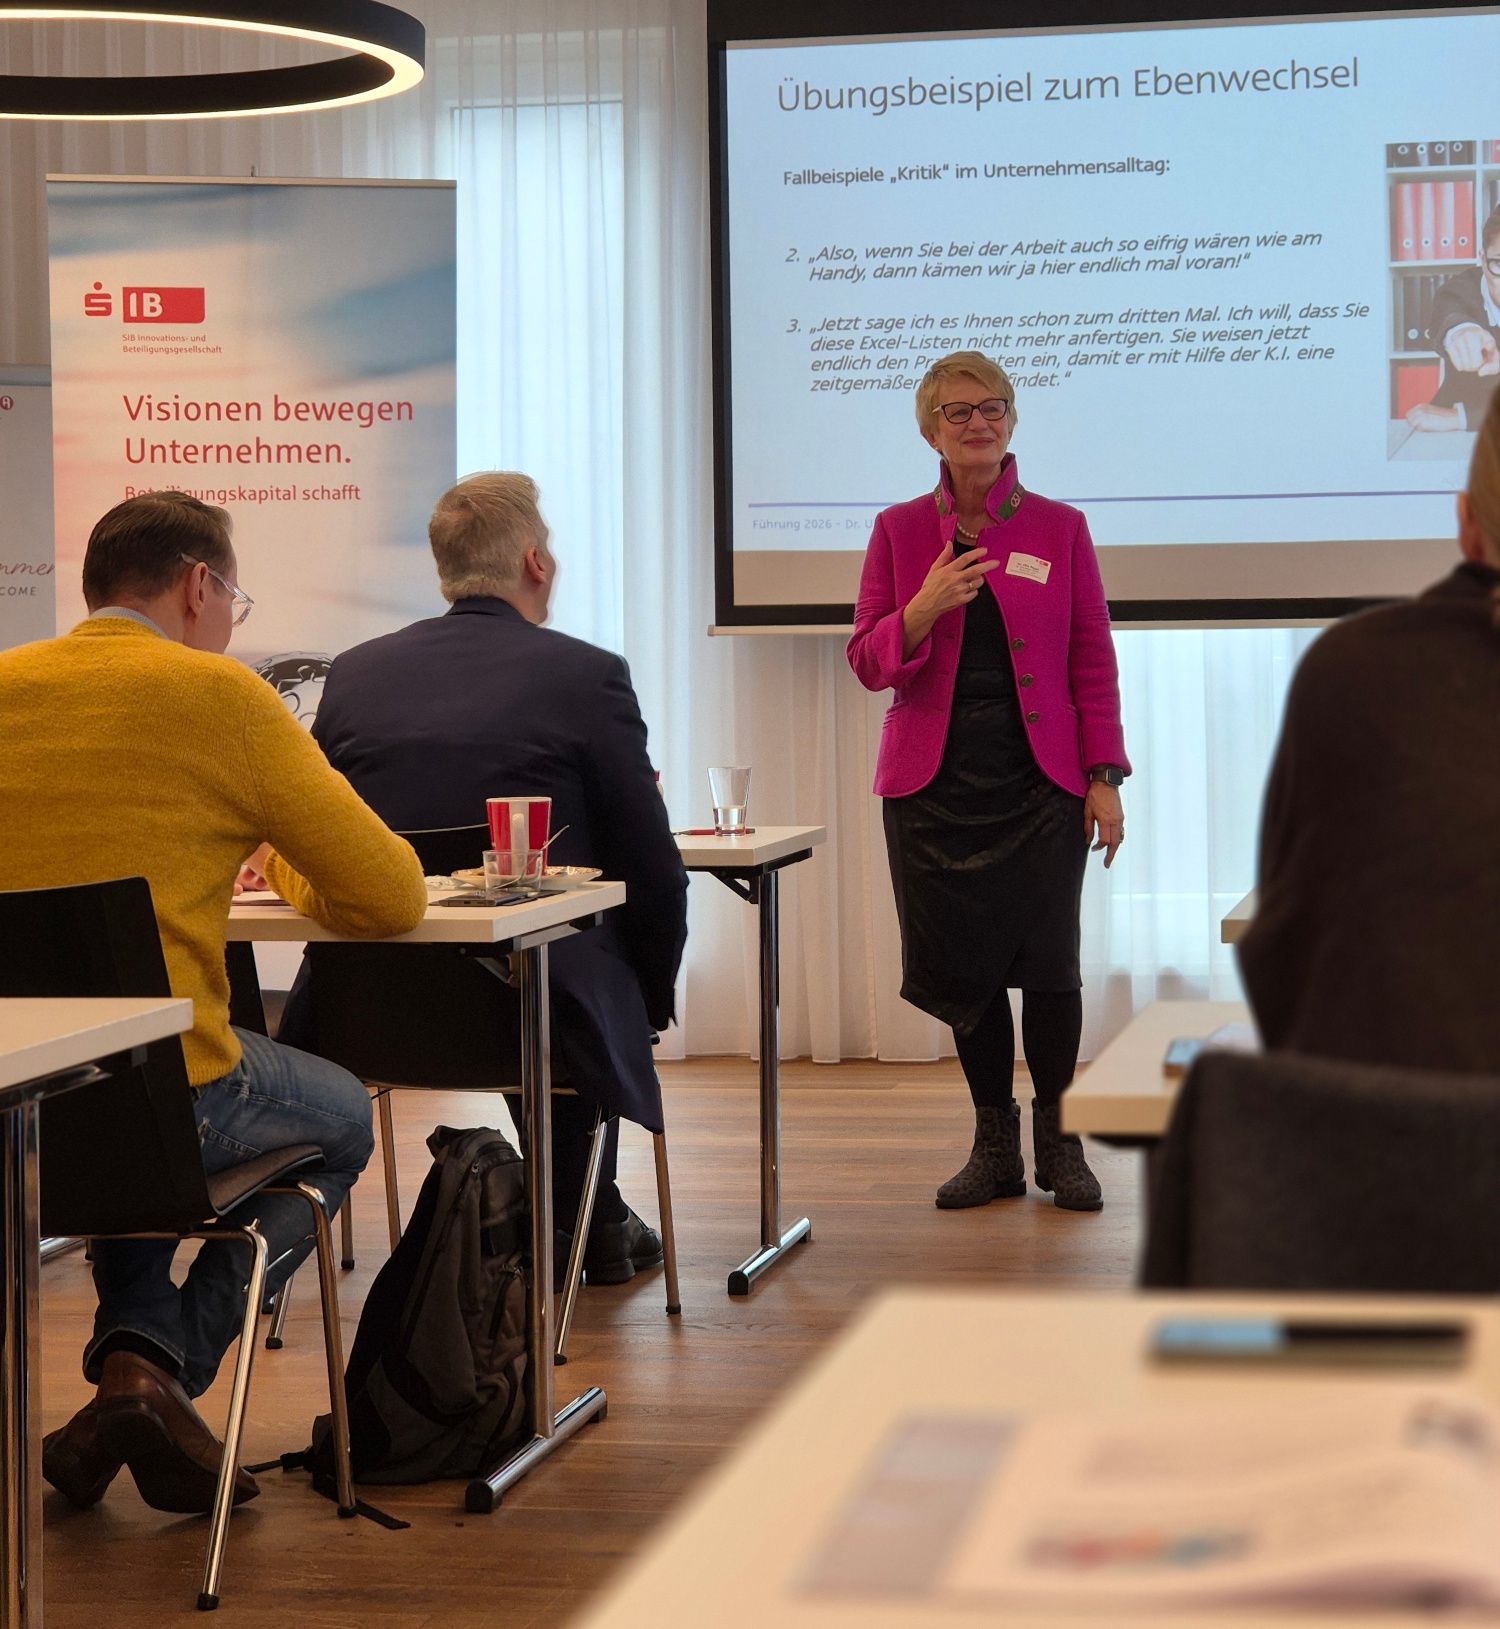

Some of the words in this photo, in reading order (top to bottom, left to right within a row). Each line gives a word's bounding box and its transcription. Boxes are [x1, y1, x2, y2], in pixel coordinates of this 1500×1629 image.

[779, 72, 1031, 116] Übungsbeispiel
[1044, 76, 1119, 101] zum
[1135, 56, 1358, 96] Ebenwechsel
[784, 166, 884, 187] Fallbeispiele
[956, 164, 977, 179] im
[984, 157, 1170, 178] Unternehmensalltag:
[785, 248, 799, 262] 2.
[866, 247, 913, 259] wenn
[917, 242, 943, 257] Sie
[948, 241, 975, 257] bei
[978, 241, 1008, 256] der
[1011, 239, 1067, 255] Arbeit
[1070, 237, 1113, 253] auch
[1117, 240, 1139, 252] so
[1143, 233, 1189, 254] eifrig
[1195, 233, 1250, 249] wären
[1257, 231, 1287, 247] wie
[1291, 234, 1322, 246] am
[810, 264, 866, 283] Handy,
[873, 263, 917, 278] dann
[922, 262, 982, 277] kämen
[988, 260, 1013, 277] wir
[1016, 260, 1035, 280] ja
[1040, 259, 1076, 275] hier
[1079, 256, 1140, 273] endlich
[1145, 253, 1179, 271] mal
[130, 292, 163, 318] IB
[786, 319, 801, 333] 3.
[865, 318, 905, 333] sage
[910, 314, 934, 329] ich
[940, 318, 959, 328] es
[964, 313, 1013, 328] Ihnen
[1018, 312, 1070, 327] schon
[1074, 313, 1113, 325] zum
[1118, 308, 1180, 324] dritten
[1185, 306, 1220, 322] Mal.
[1228, 305, 1253, 321] Ich
[1260, 303, 1291, 322] will,
[1299, 303, 1339, 318] dass
[1343, 302, 1369, 317] Sie
[122, 333, 136, 342] SIB
[190, 333, 206, 342] und
[122, 345, 222, 355] Beteiligungsgesellschaft
[811, 336, 854, 351] diese
[860, 334, 961, 350] Excel-Listen
[968, 333, 1012, 347] nicht
[1016, 331, 1065, 347] mehr
[1068, 329, 1163, 348] anfertigen.
[1170, 328, 1196, 343] Sie
[1203, 326, 1263, 342] weisen
[1264, 325, 1311, 344] jetzt
[811, 355, 871, 371] endlich
[877, 355, 908, 369] den
[1031, 352, 1060, 368] ein,
[1068, 350, 1121, 366] damit
[1126, 353, 1145, 364] er
[1148, 348, 1181, 364] mit
[1185, 346, 1225, 363] Hilfe
[1230, 346, 1261, 362] der
[1265, 346, 1289, 360] K.I.
[1297, 345, 1335, 360] eine
[123, 394, 261, 421] Visionen
[274, 394, 413, 428] bewegen
[126, 436, 351, 464] Unternehmen.
[303, 484, 360, 500] schafft
[752, 519, 801, 531] Führung
[804, 519, 832, 529] 2026
[845, 519, 860, 529] Dr.
